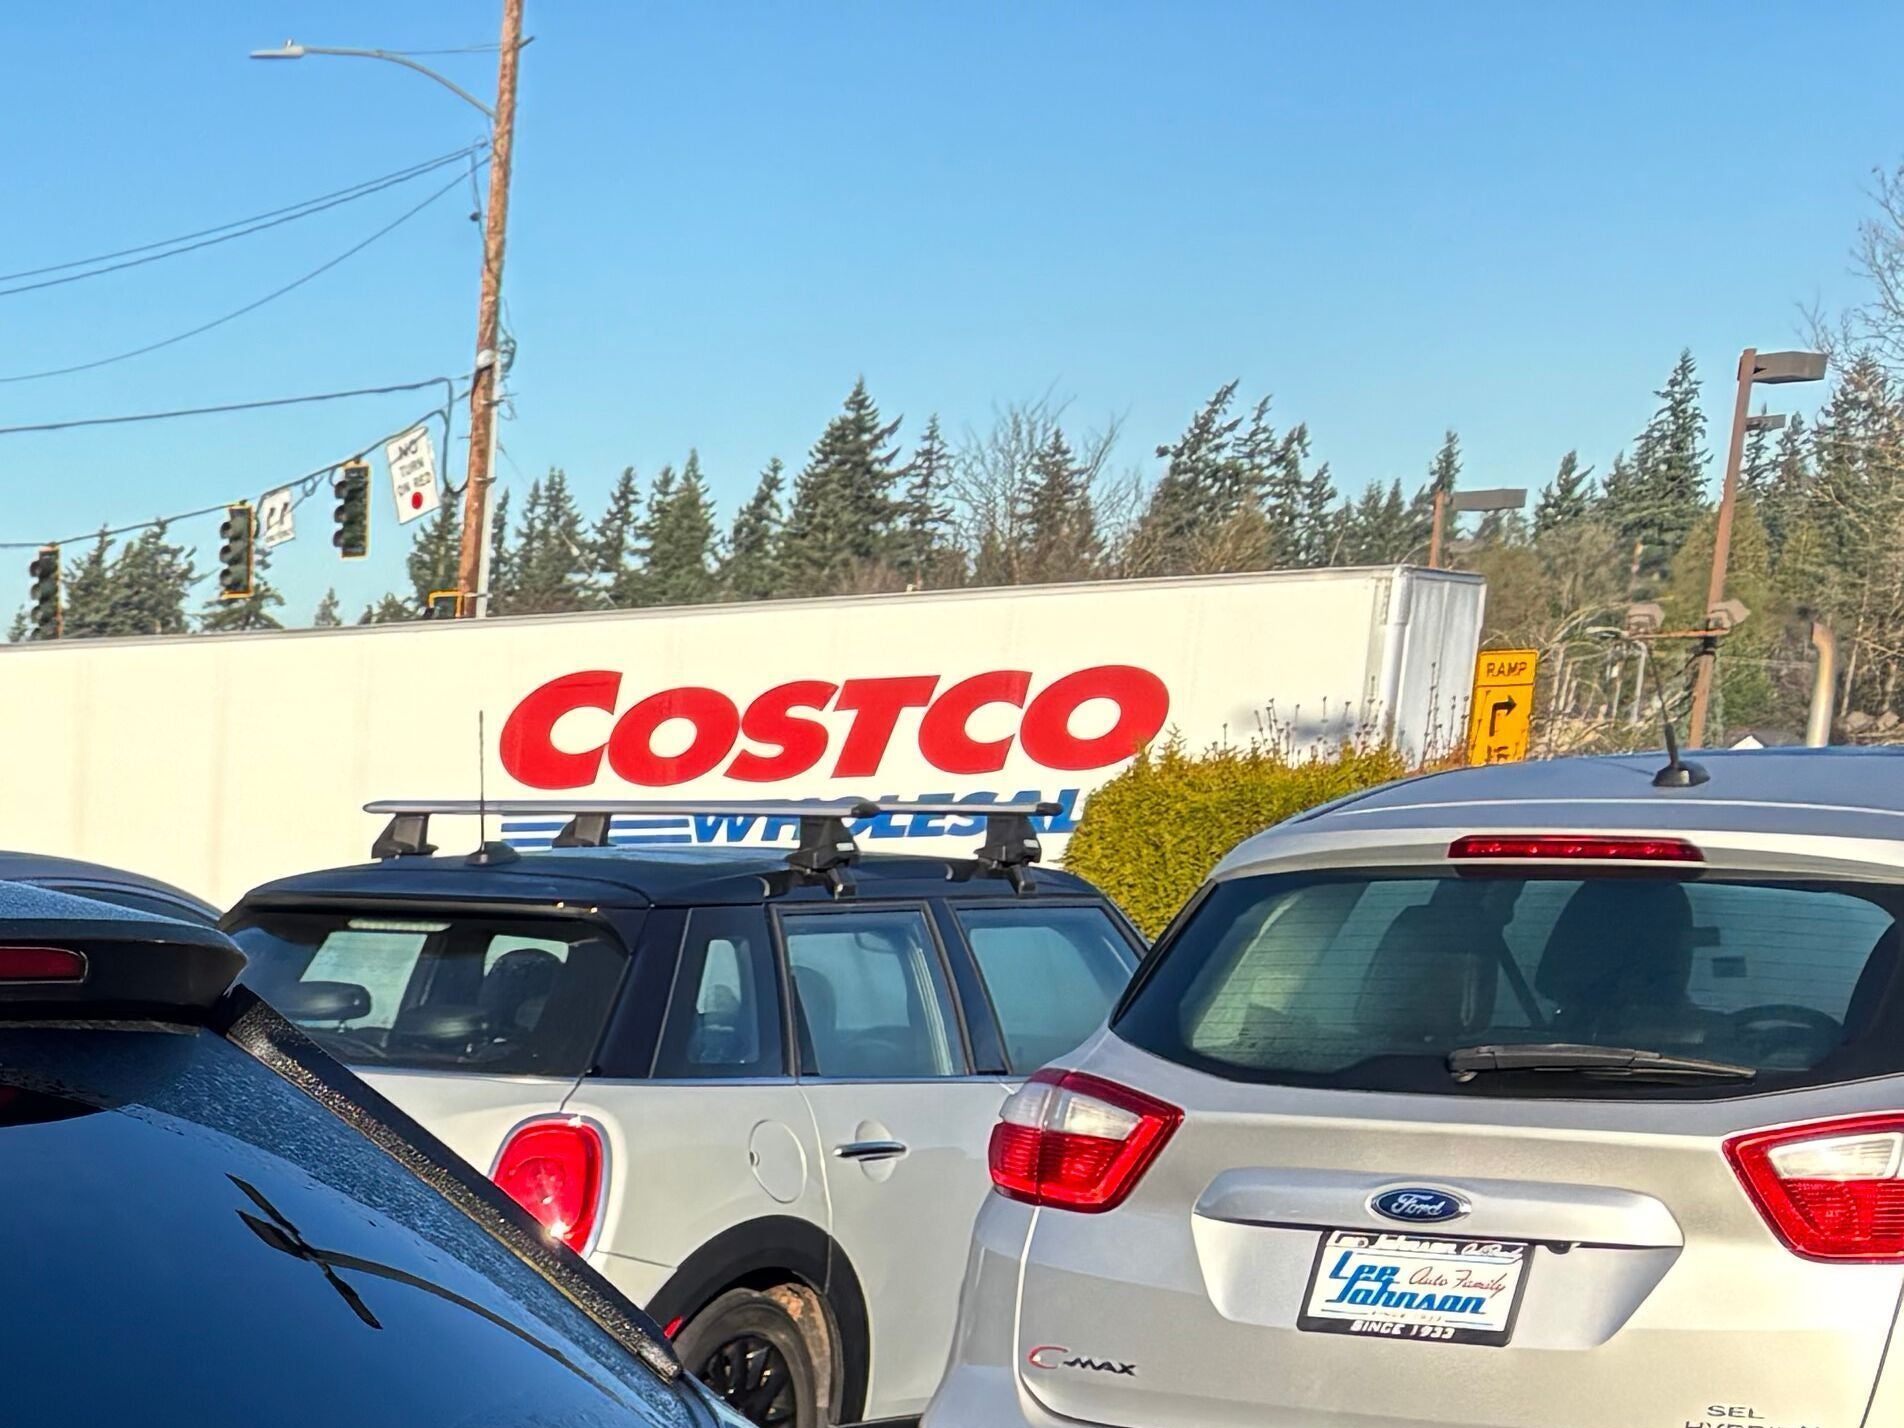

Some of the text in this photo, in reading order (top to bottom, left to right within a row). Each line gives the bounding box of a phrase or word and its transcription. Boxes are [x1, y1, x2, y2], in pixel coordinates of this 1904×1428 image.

[1486, 661, 1528, 678] RAMP
[499, 664, 1170, 790] COSTCO
[1391, 1193, 1444, 1216] Ford
[1328, 1251, 1508, 1299] Lee Auto Family
[1325, 1276, 1487, 1315] Johnson
[1350, 1319, 1456, 1340] SINCE 1933
[1707, 1405, 1766, 1420] SEL
